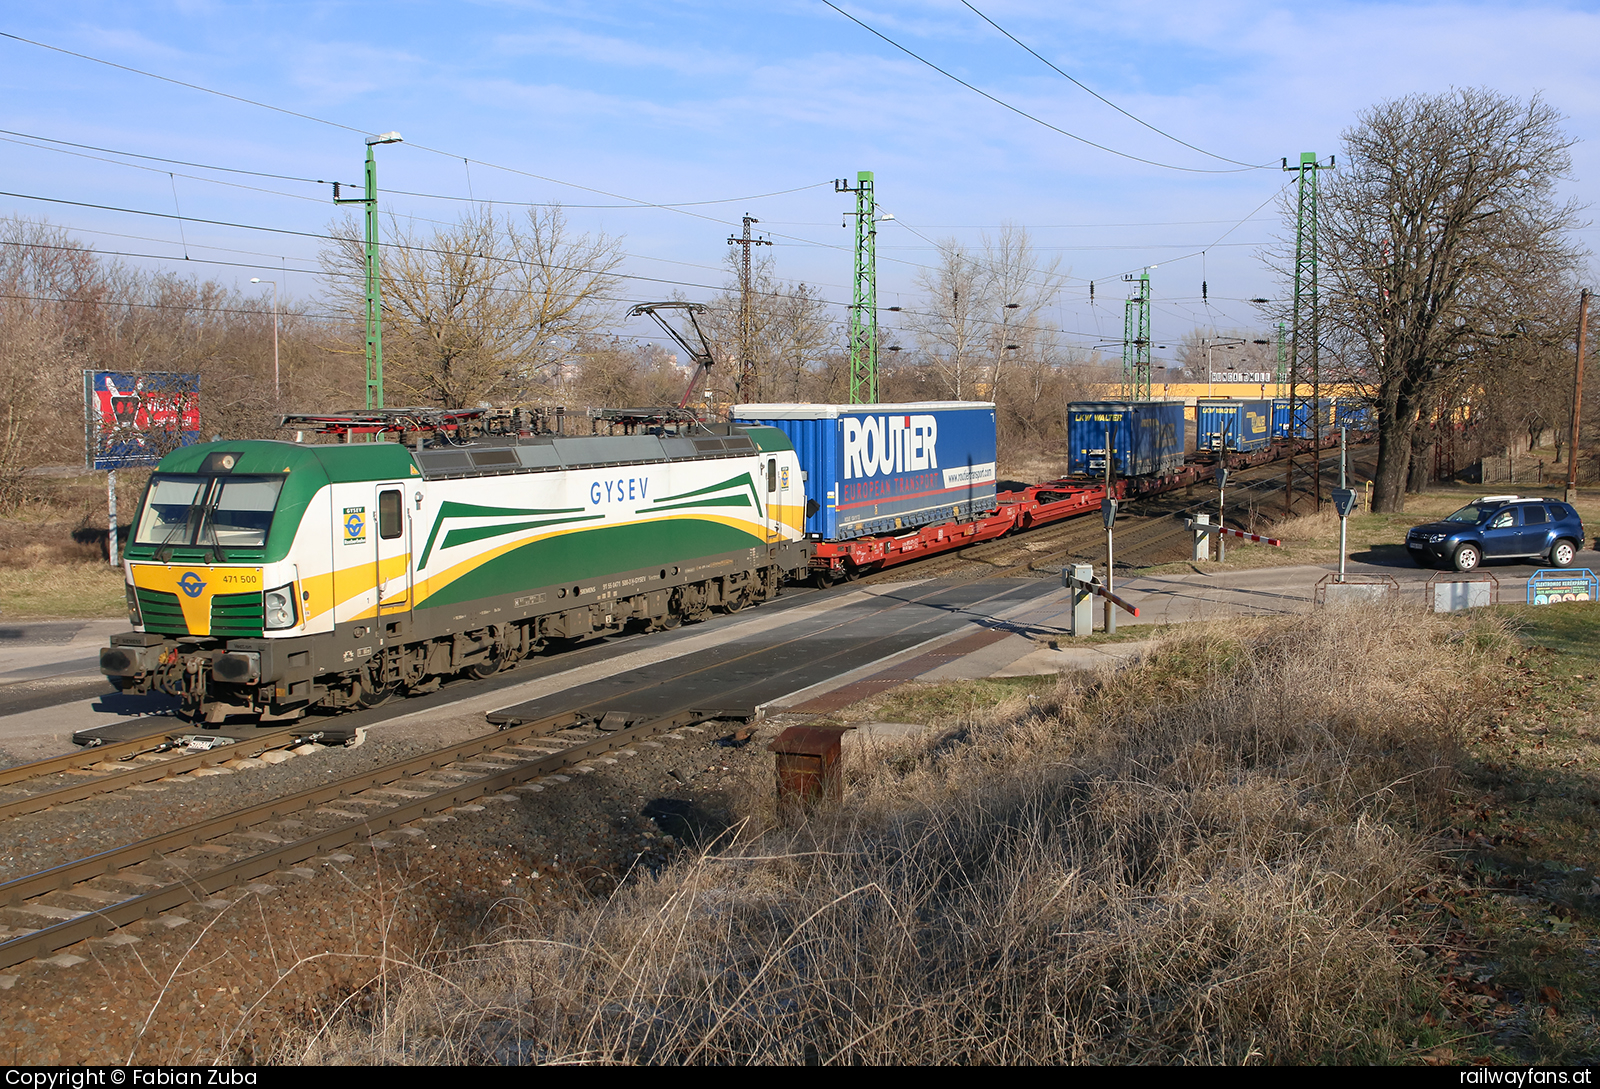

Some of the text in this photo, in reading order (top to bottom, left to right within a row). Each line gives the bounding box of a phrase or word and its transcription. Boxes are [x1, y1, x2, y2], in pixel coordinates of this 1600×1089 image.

[1075, 414, 1123, 422] LKW WALTER
[590, 477, 648, 505] GYSEV
[844, 472, 939, 502] EUROPEAN TRANSPORT
[223, 575, 257, 583] 471 500
